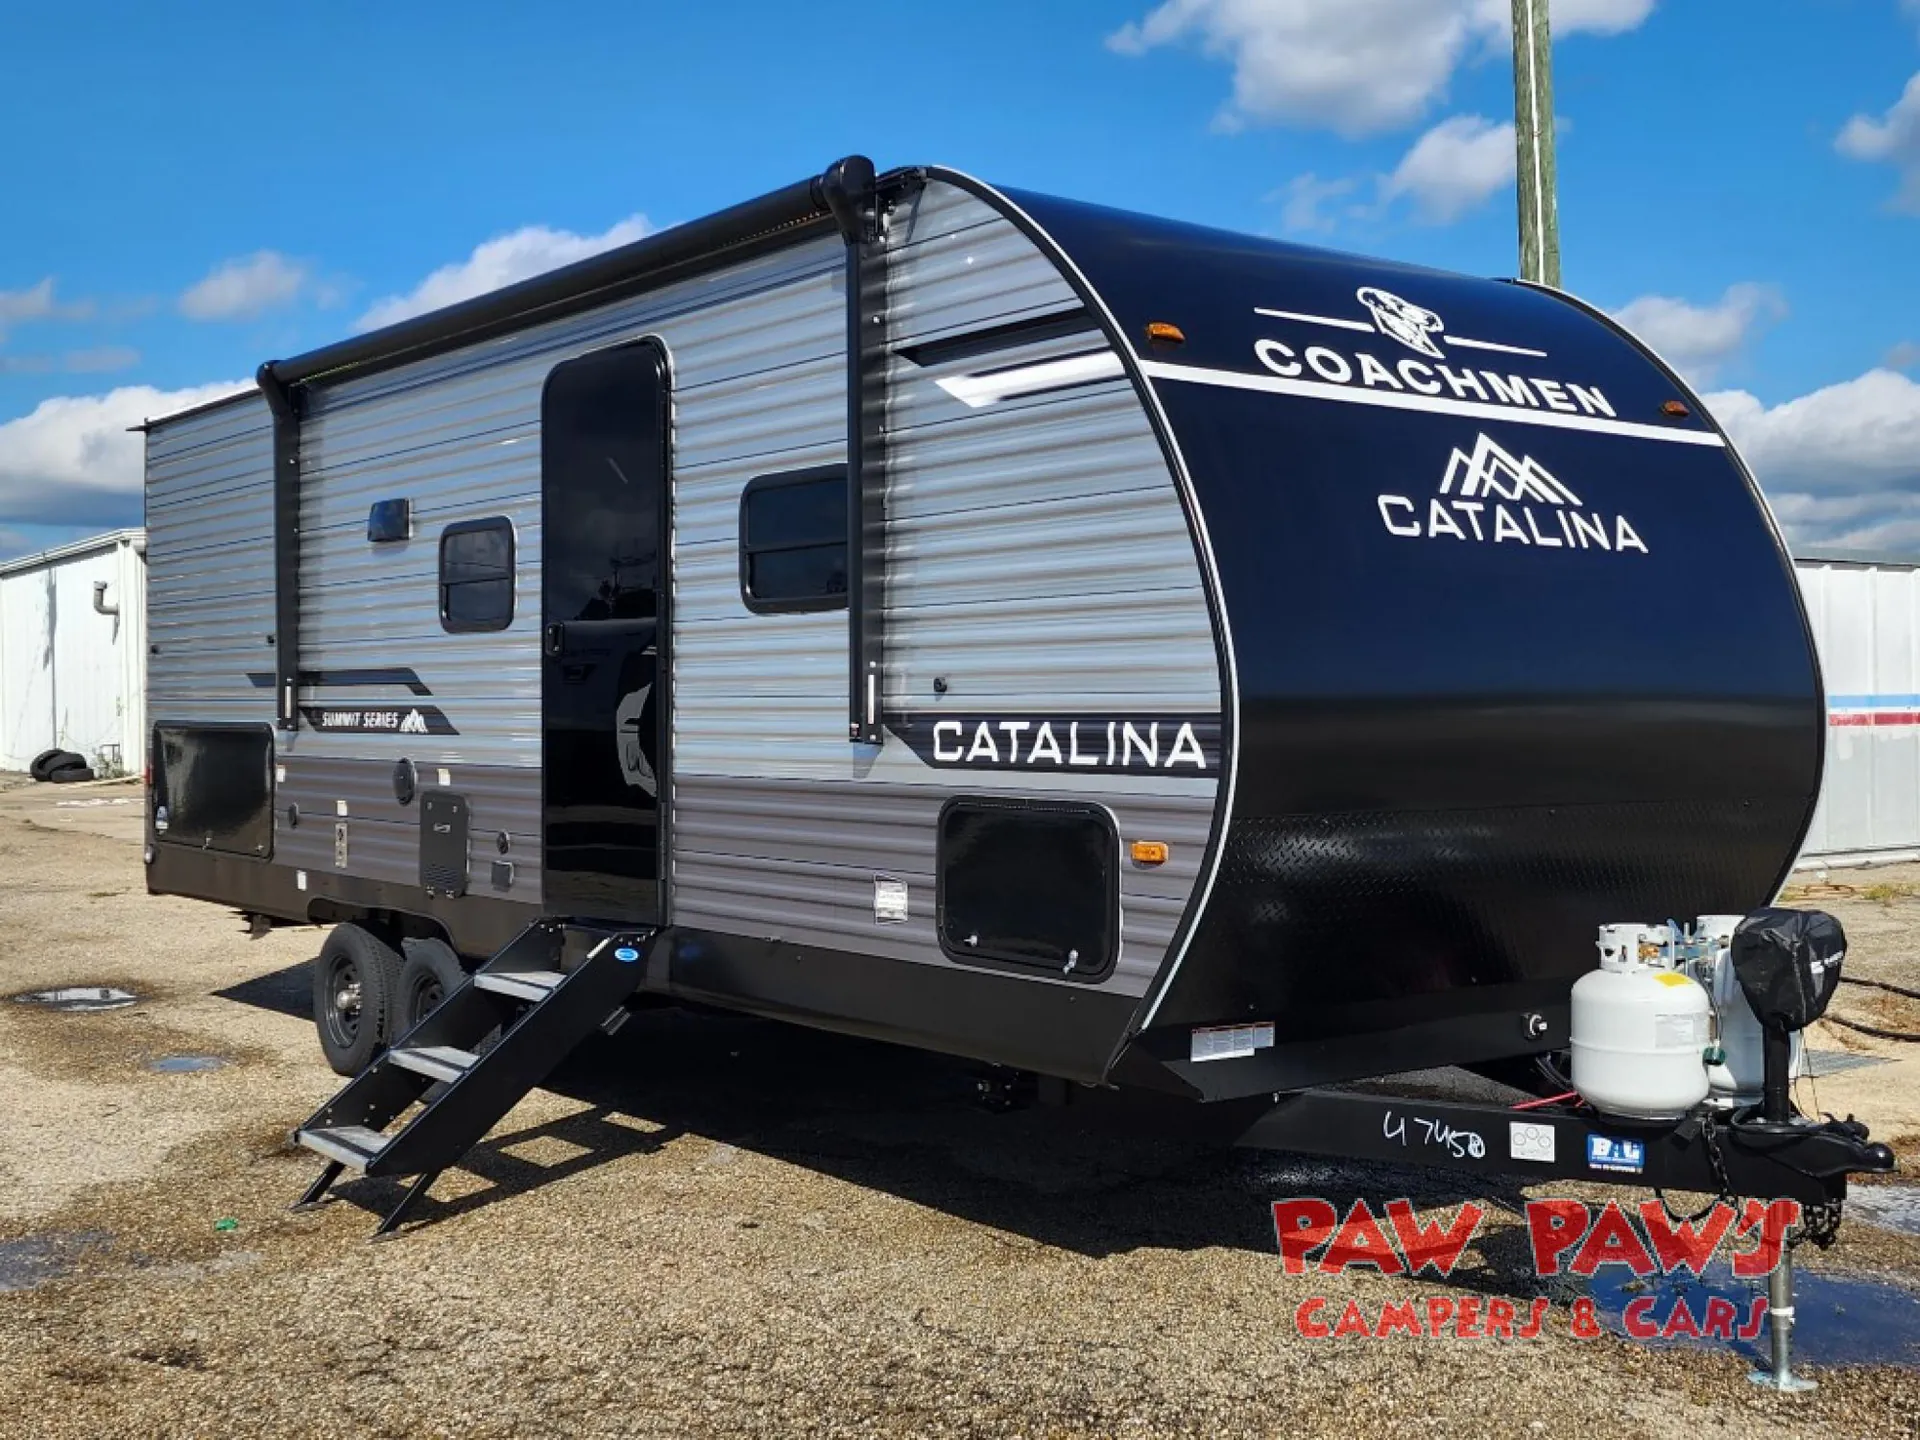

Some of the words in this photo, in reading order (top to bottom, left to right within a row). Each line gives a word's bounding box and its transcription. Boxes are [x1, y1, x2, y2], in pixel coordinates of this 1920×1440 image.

[1254, 338, 1617, 417] COACHMEN
[1377, 494, 1649, 554] CATALINA
[322, 711, 361, 727] SUMMIT
[363, 711, 398, 728] SERIES
[932, 721, 1207, 770] CATALINA
